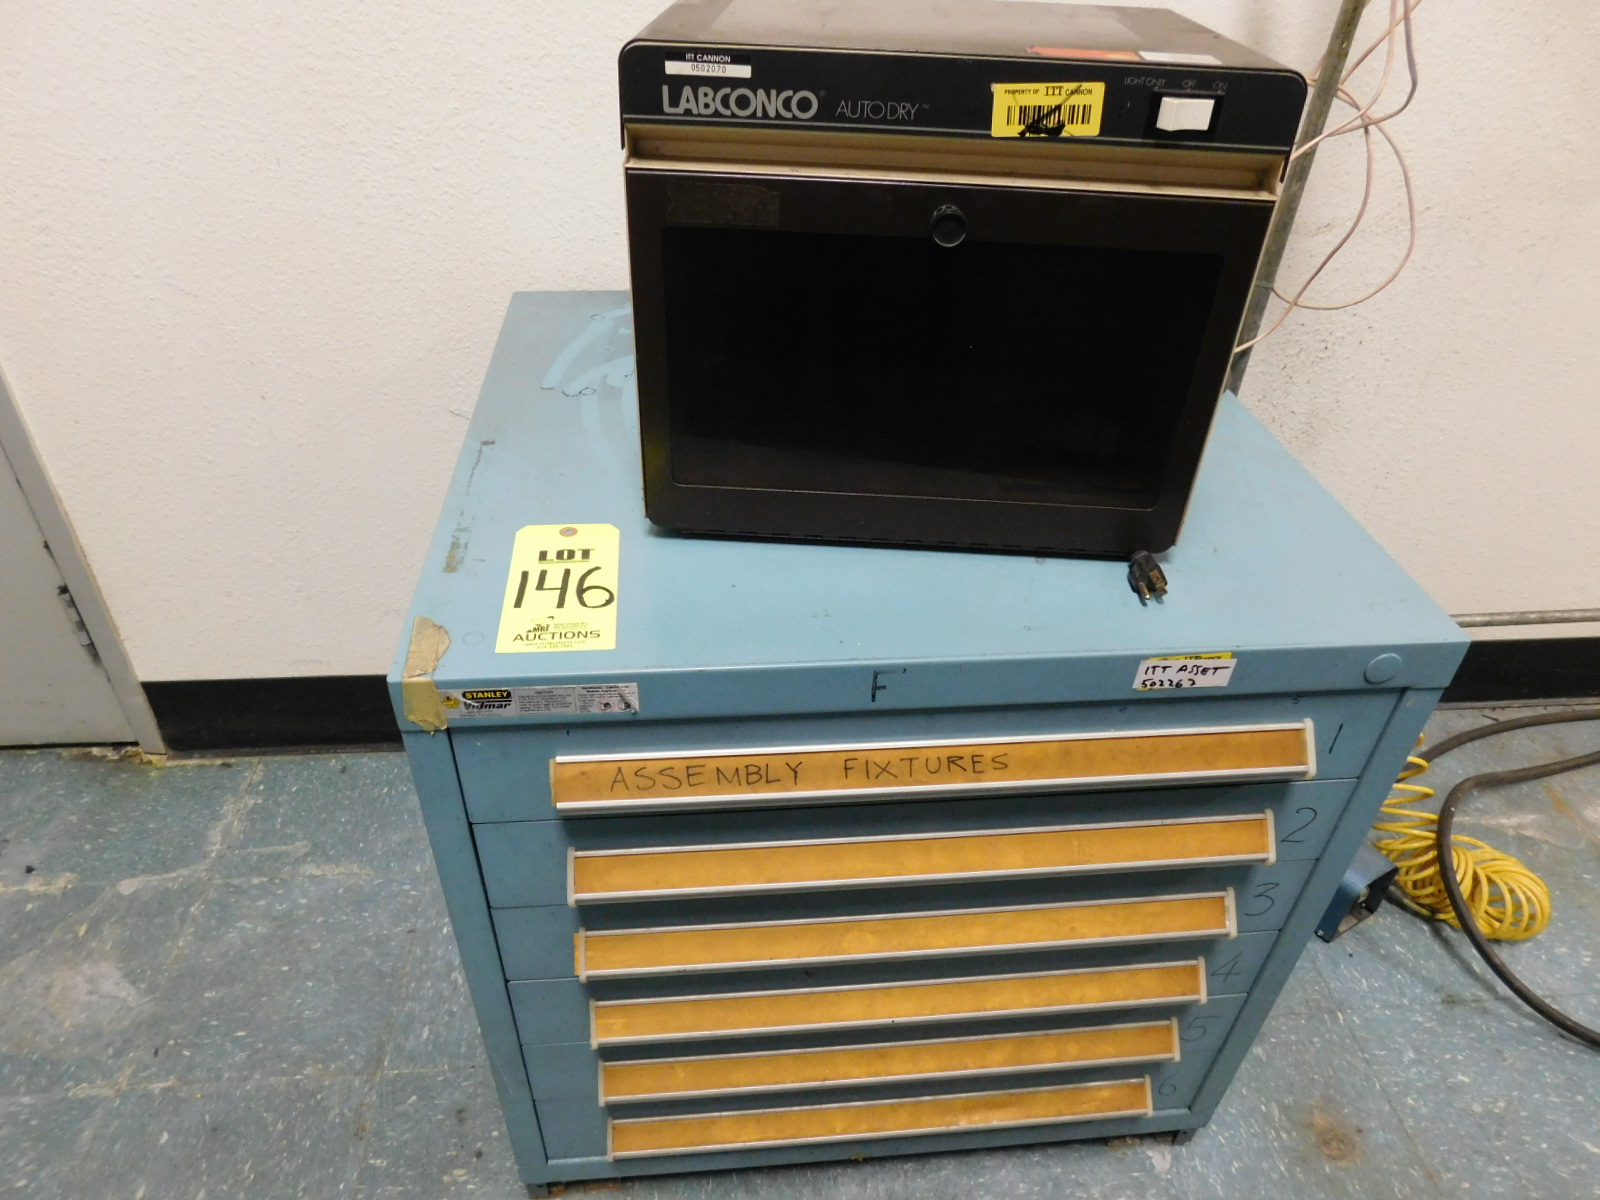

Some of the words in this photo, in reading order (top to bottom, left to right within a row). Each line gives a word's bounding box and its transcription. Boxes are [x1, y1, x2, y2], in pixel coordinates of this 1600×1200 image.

[696, 54, 731, 63] CANNON
[691, 63, 727, 74] 0502070
[1145, 77, 1167, 87] ONLY
[1182, 79, 1197, 88] OFF
[1212, 80, 1228, 90] ON
[1004, 88, 1031, 96] PROPERTY
[1043, 85, 1065, 97] ITT
[1065, 88, 1093, 97] CANNON
[661, 84, 819, 120] LABCONCO
[538, 548, 595, 562] LOT
[513, 565, 615, 609] 146
[512, 629, 601, 642] AUCTIONS
[1176, 664, 1230, 676] ASSET
[465, 691, 508, 699] STANLEY
[463, 701, 512, 711] Vidmar
[609, 761, 804, 793] ASSEMBLY
[843, 752, 1009, 780] FIXTURES
[1280, 806, 1318, 843] 2
[1244, 881, 1280, 917] 3
[1209, 950, 1243, 983] 4
[1180, 1015, 1221, 1043] 5
